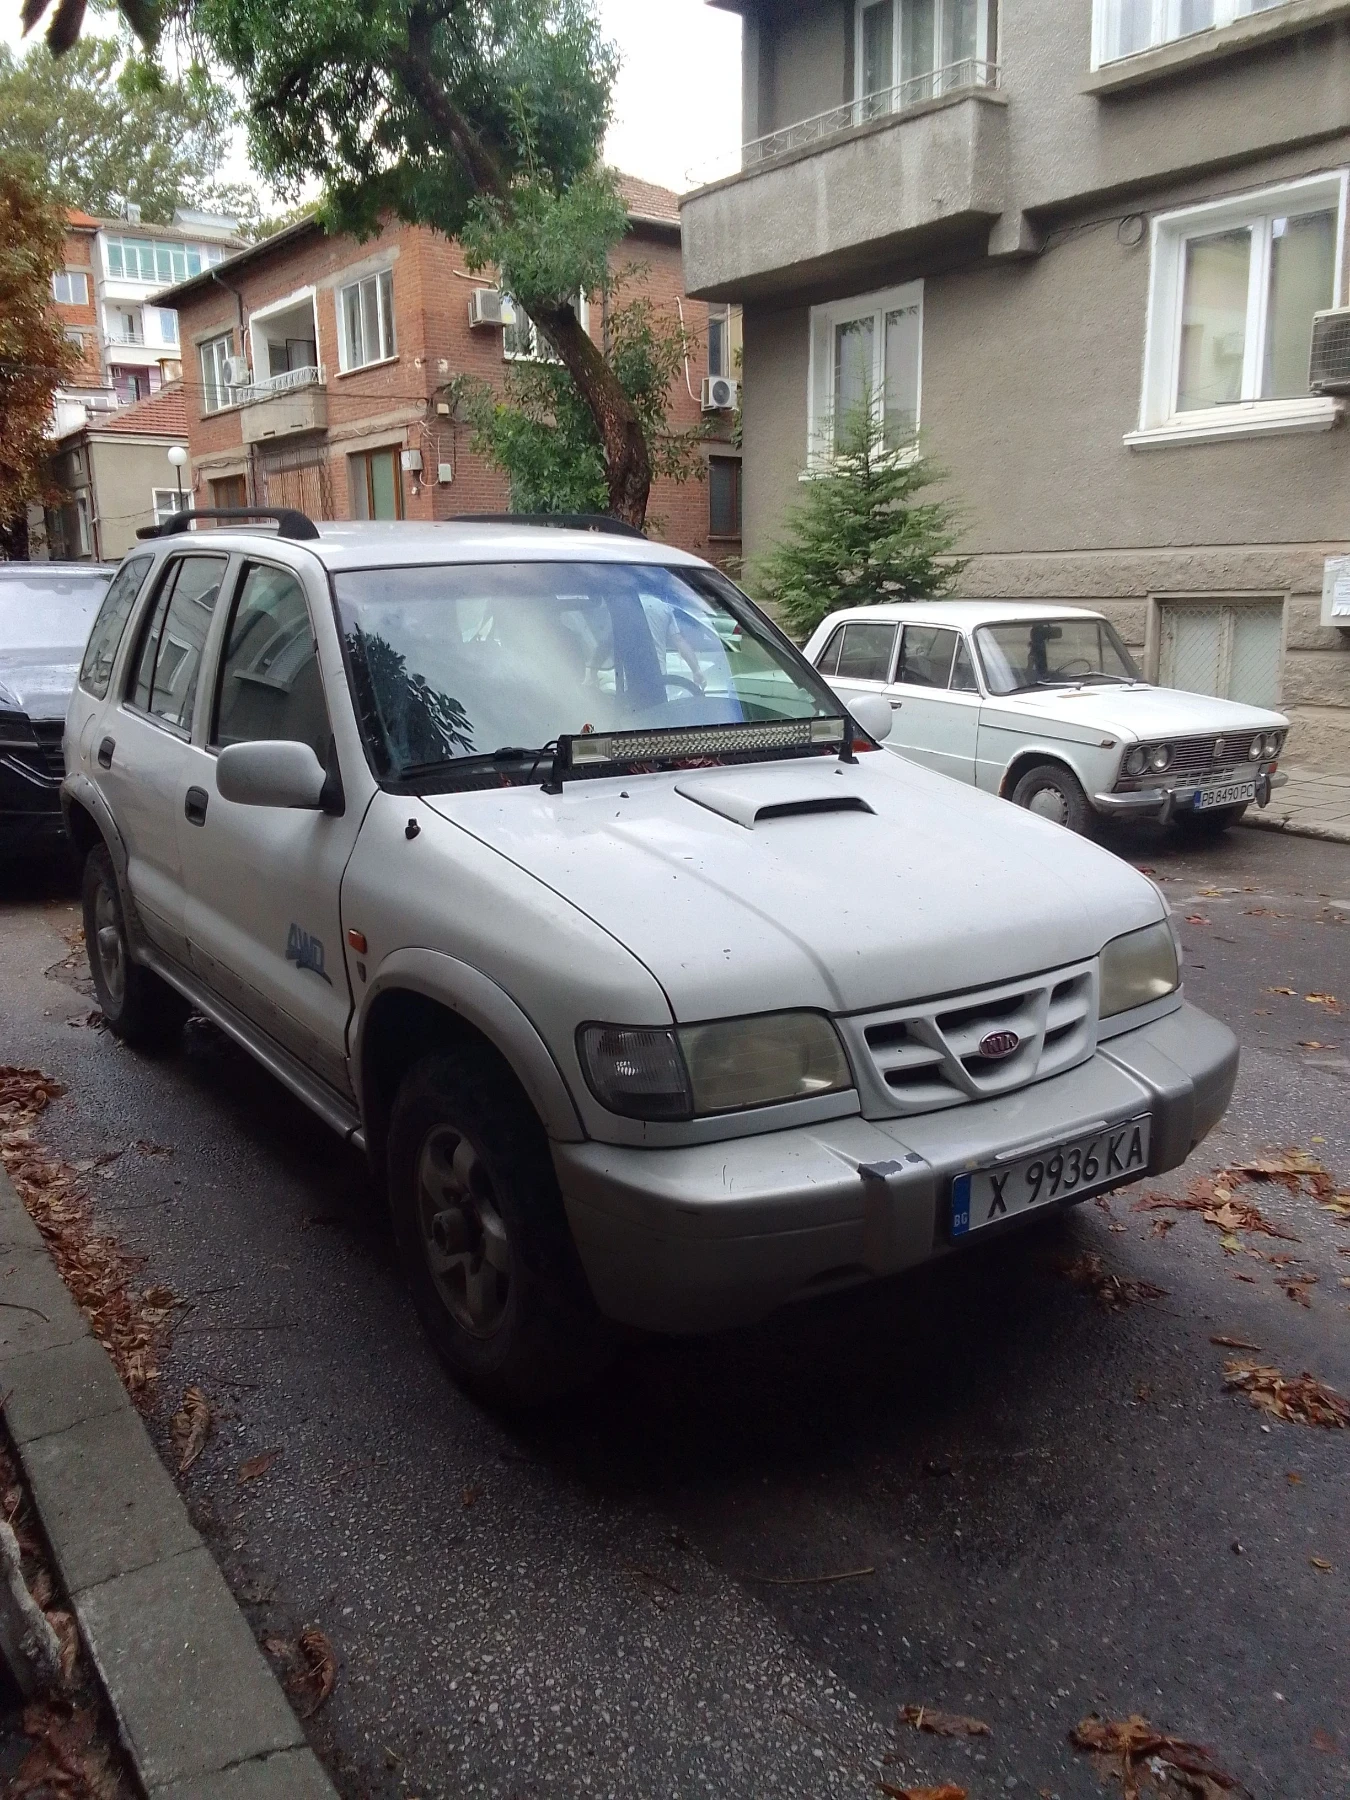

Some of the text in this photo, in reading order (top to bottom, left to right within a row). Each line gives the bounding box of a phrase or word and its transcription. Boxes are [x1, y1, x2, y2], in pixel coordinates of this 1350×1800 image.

[1202, 791, 1214, 806] PB
[1216, 786, 1239, 803] 8490
[1241, 784, 1253, 798] PC
[984, 1034, 1016, 1053] KIA
[987, 1125, 1143, 1219] X 9936 KA
[953, 1211, 968, 1227] BG
